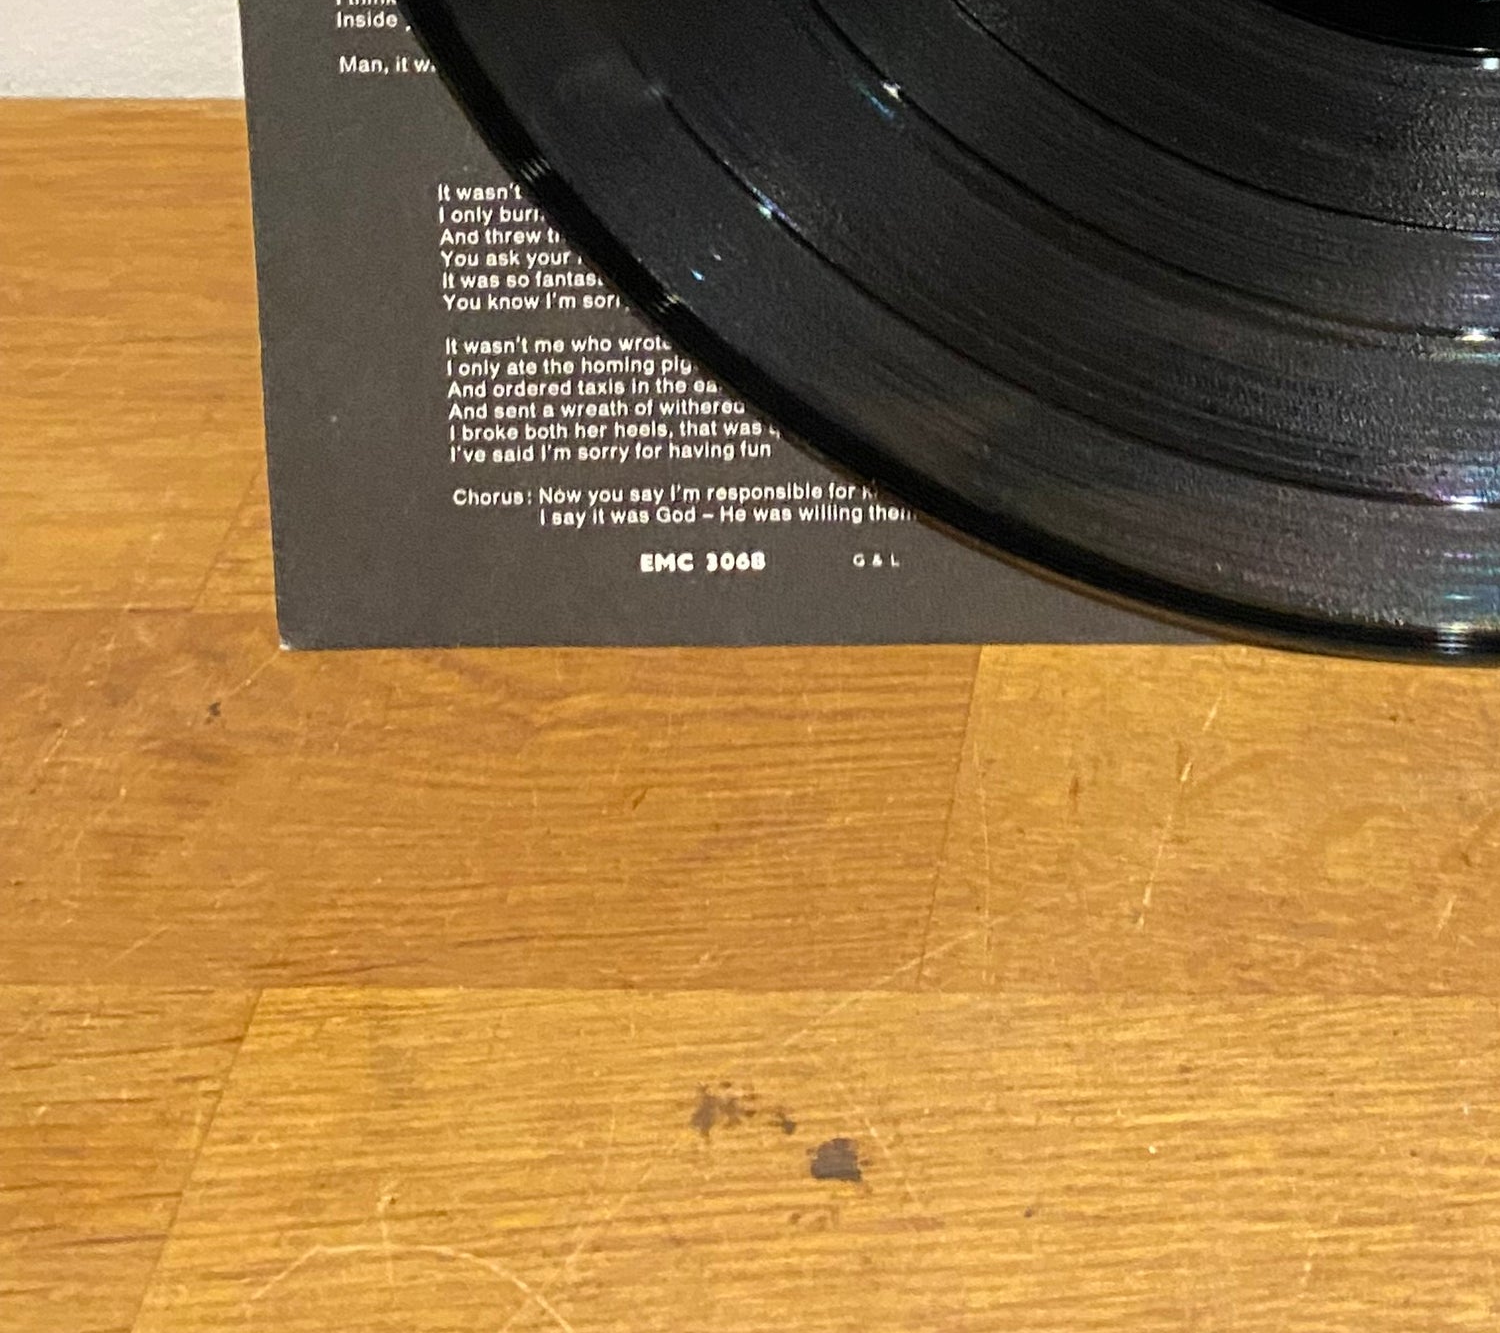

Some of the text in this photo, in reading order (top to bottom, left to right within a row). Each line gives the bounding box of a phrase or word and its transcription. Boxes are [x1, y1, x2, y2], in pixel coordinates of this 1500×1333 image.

[338, 55, 408, 75] Man, it
[445, 334, 612, 355] It wasn't me who
[450, 439, 771, 463] I've said I'm sorry for having fun
[639, 550, 766, 573] EMC 3068
